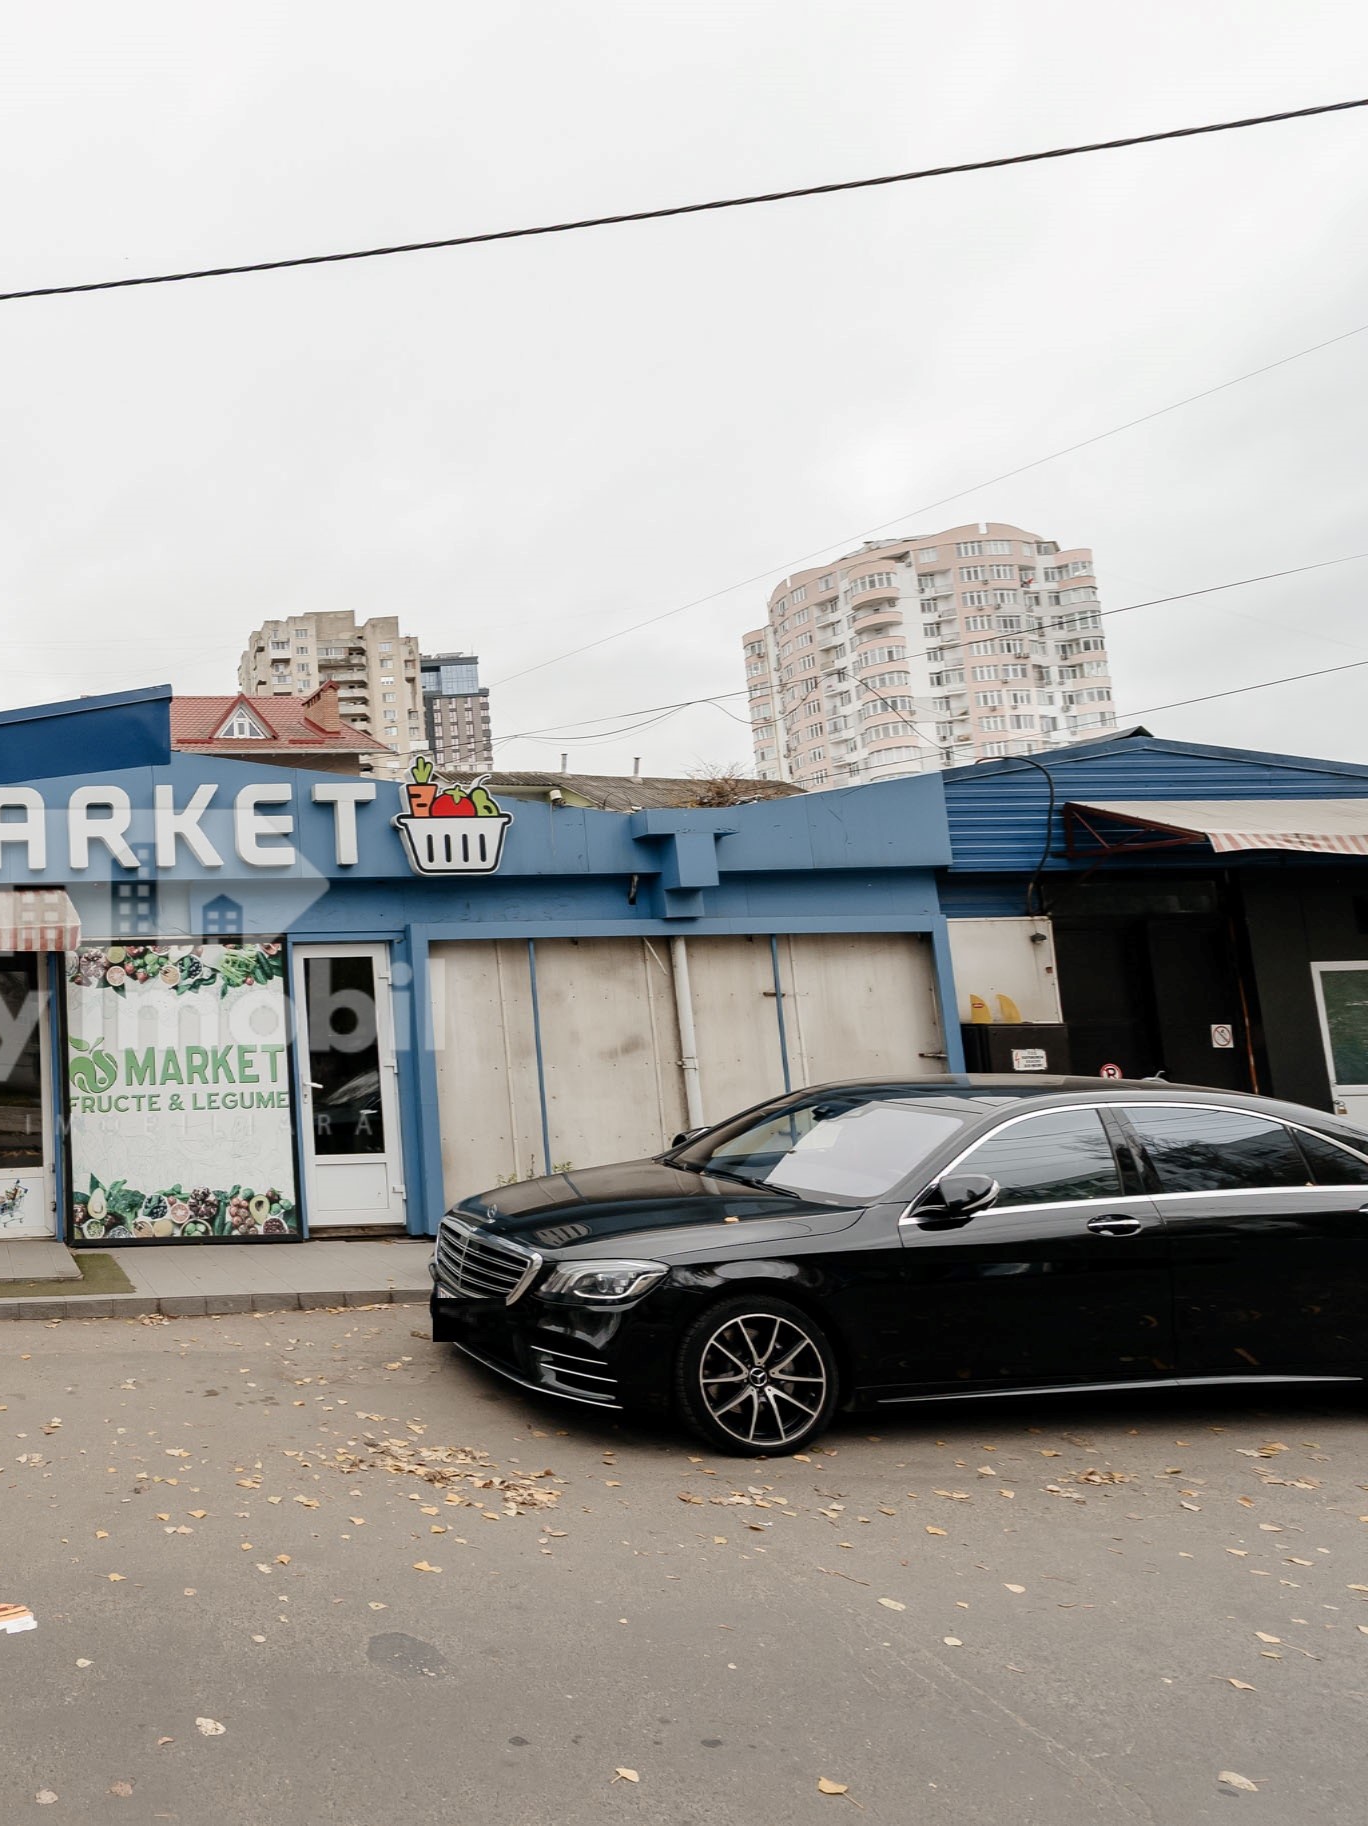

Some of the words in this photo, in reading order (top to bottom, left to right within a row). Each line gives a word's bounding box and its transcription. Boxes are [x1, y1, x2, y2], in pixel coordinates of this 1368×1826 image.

[125, 1043, 286, 1088] MARKET
[70, 1094, 161, 1114] FRUCTE
[168, 1094, 185, 1111] &
[192, 1090, 290, 1111] LEGUME
